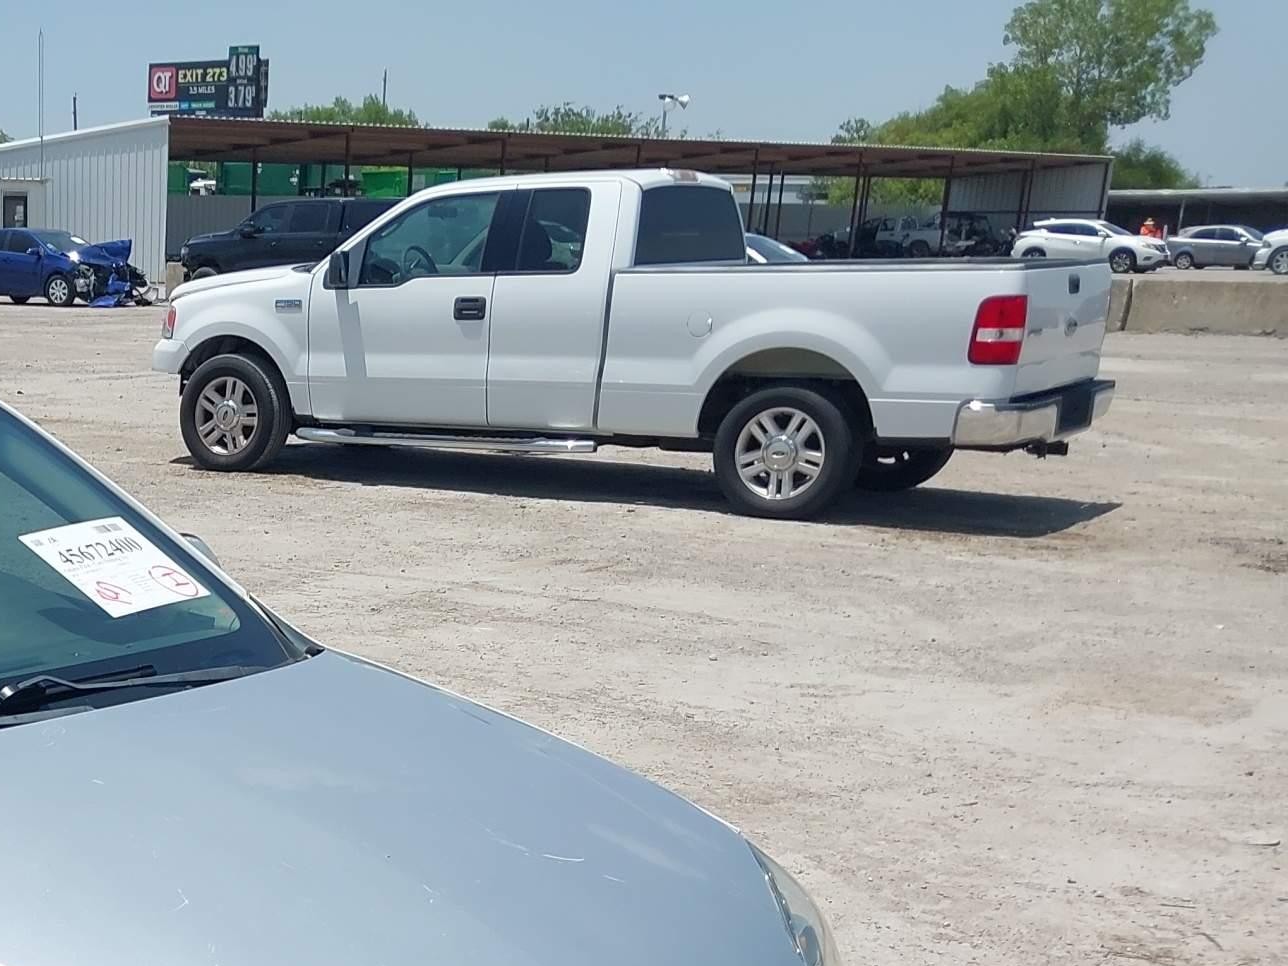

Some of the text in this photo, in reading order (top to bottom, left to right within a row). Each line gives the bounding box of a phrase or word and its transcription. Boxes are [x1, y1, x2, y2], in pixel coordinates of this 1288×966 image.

[153, 71, 172, 94] QT
[178, 67, 228, 83] EXIT 273
[198, 85, 216, 93] MILES
[59, 536, 143, 565] 45672400
